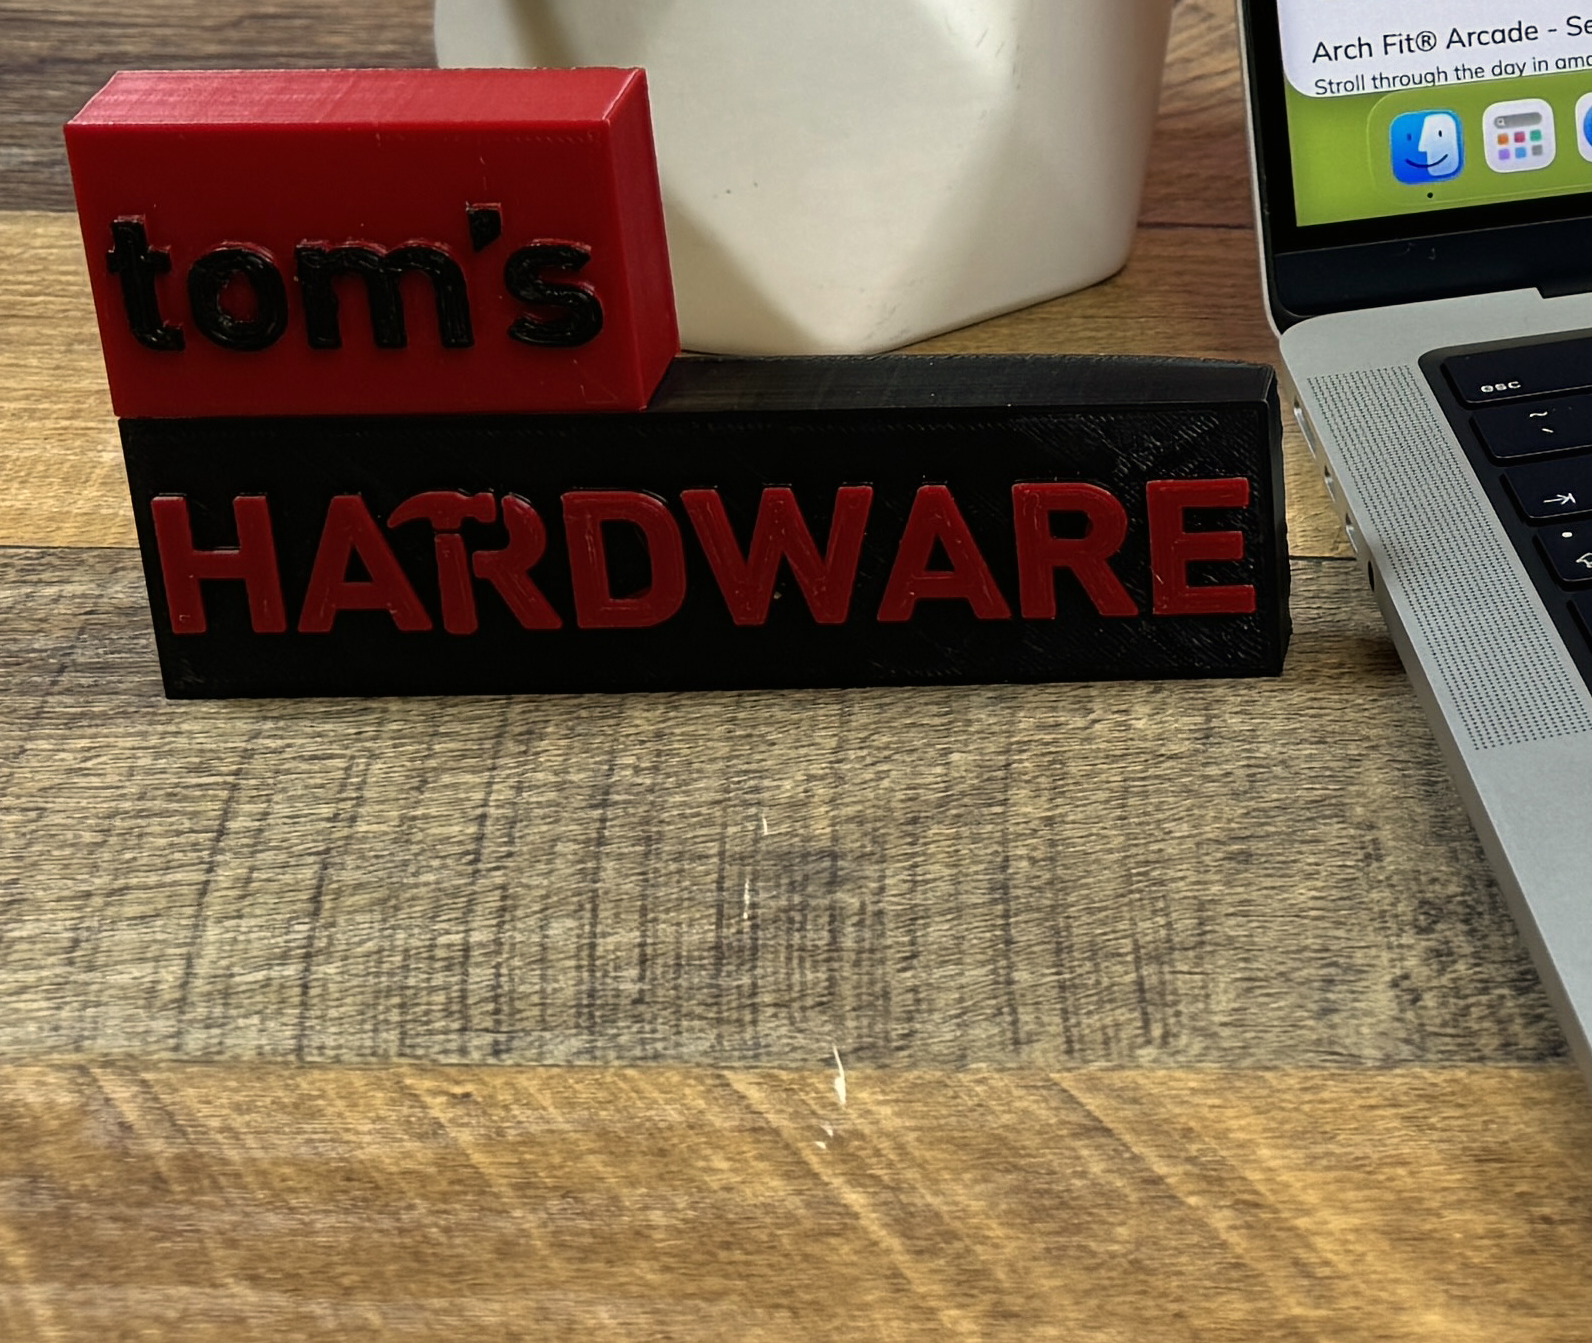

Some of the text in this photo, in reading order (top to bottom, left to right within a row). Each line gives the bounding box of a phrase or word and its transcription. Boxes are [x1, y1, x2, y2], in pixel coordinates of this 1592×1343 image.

[1311, 36, 1373, 63] Arch
[1382, 30, 1437, 55] Fit®
[1445, 19, 1538, 49] Arcade
[1314, 75, 1365, 95] Stroll
[1371, 67, 1448, 87] through
[1454, 63, 1485, 81] the
[1491, 60, 1526, 76] day
[1532, 57, 1548, 71] in
[106, 202, 605, 351] tom's
[1481, 382, 1520, 392] esc
[149, 476, 1256, 636] HARDWARE
